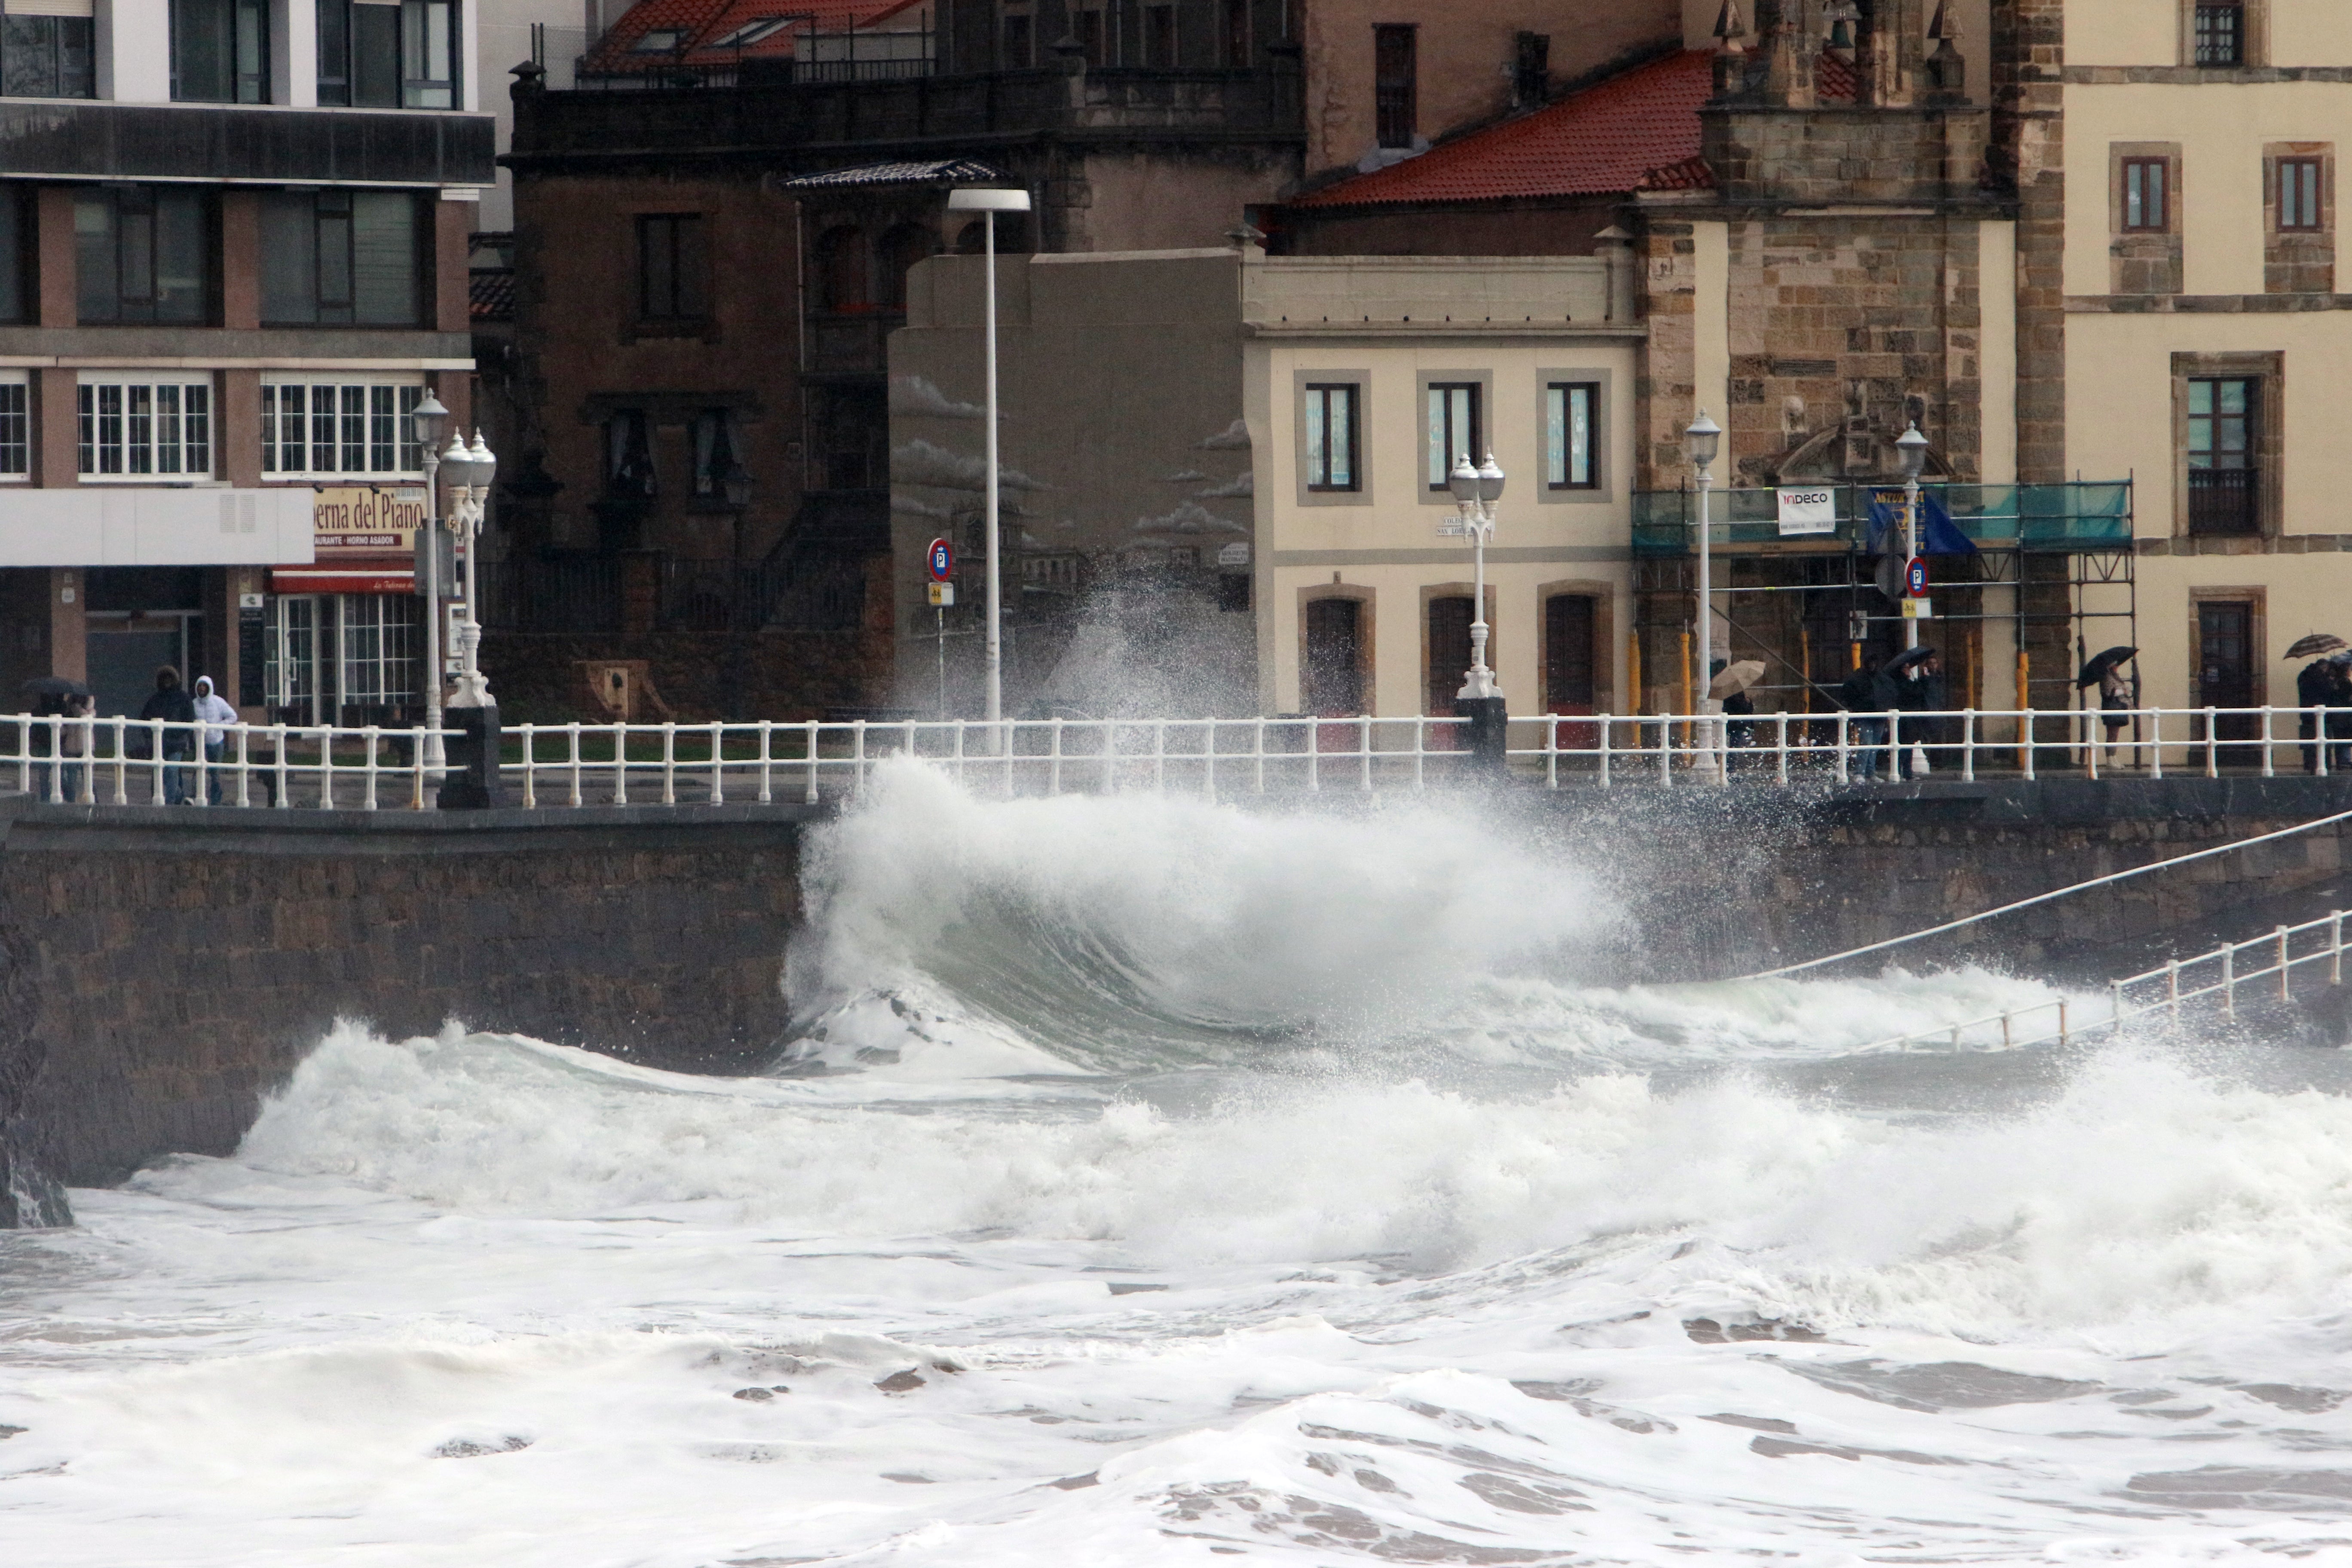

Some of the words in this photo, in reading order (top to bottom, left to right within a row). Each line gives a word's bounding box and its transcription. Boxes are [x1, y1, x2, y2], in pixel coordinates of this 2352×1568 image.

[354, 492, 377, 529] del
[382, 493, 423, 529] Piano
[346, 536, 369, 545] HORNO
[369, 536, 394, 545] ASADOR
[938, 554, 943, 566] P
[1915, 571, 1920, 583] P
